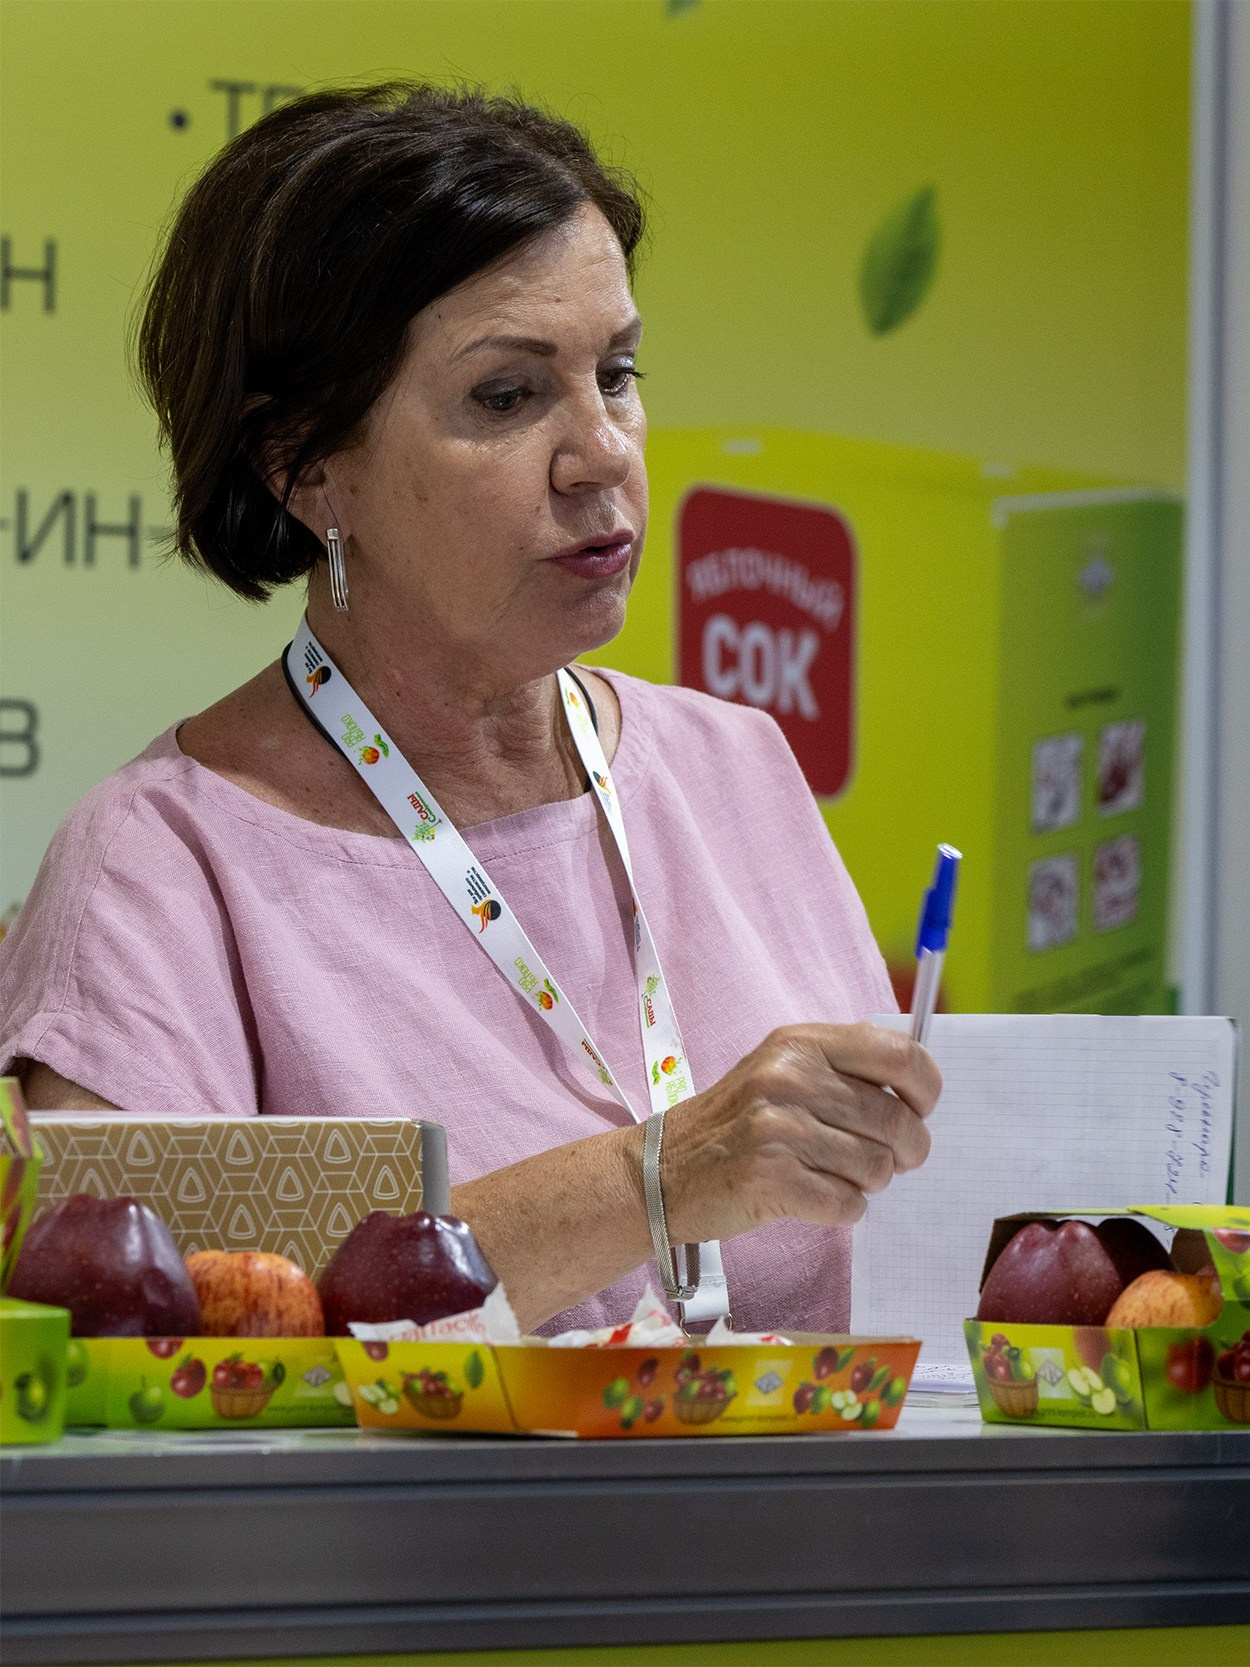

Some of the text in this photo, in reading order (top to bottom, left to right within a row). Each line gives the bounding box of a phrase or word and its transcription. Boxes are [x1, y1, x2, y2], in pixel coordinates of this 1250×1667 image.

[704, 614, 819, 720] СОК
[407, 794, 429, 820] САДЫ
[646, 999, 656, 1026] САДЫ
